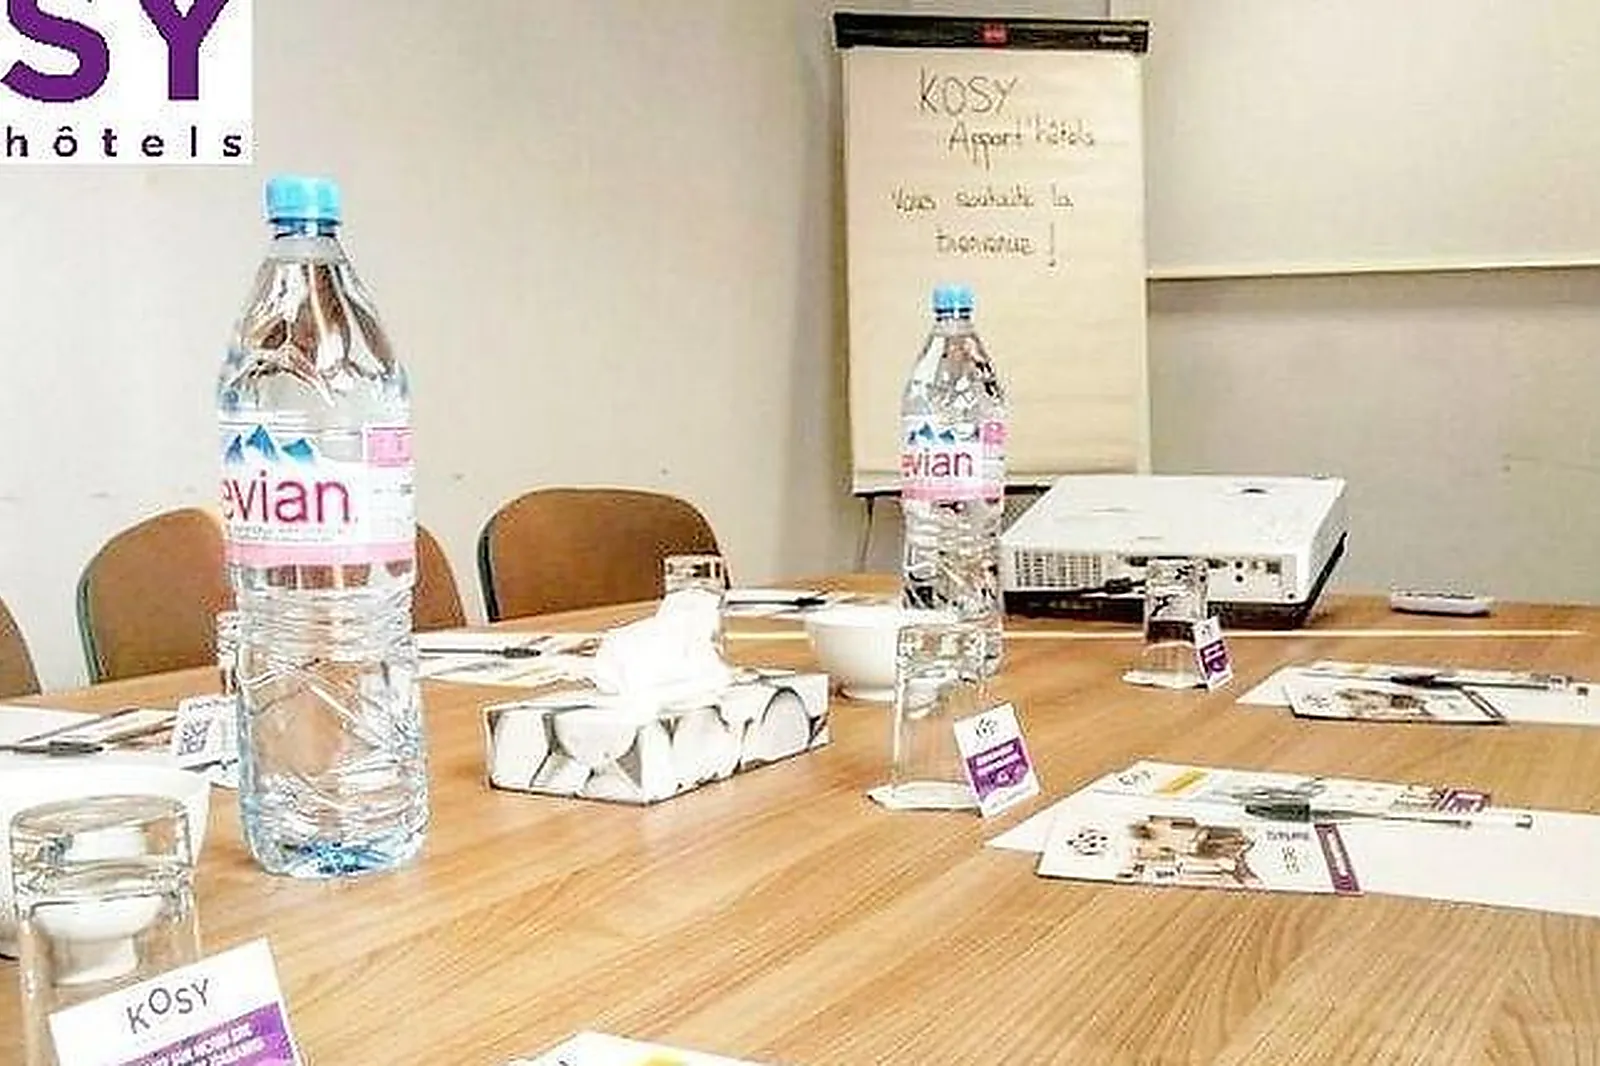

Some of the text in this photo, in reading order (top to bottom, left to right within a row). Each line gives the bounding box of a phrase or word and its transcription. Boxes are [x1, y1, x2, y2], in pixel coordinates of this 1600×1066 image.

[918, 65, 1018, 116] KOSY
[901, 447, 973, 477] evian
[221, 469, 350, 523] evian
[126, 978, 210, 1034] KOSY
